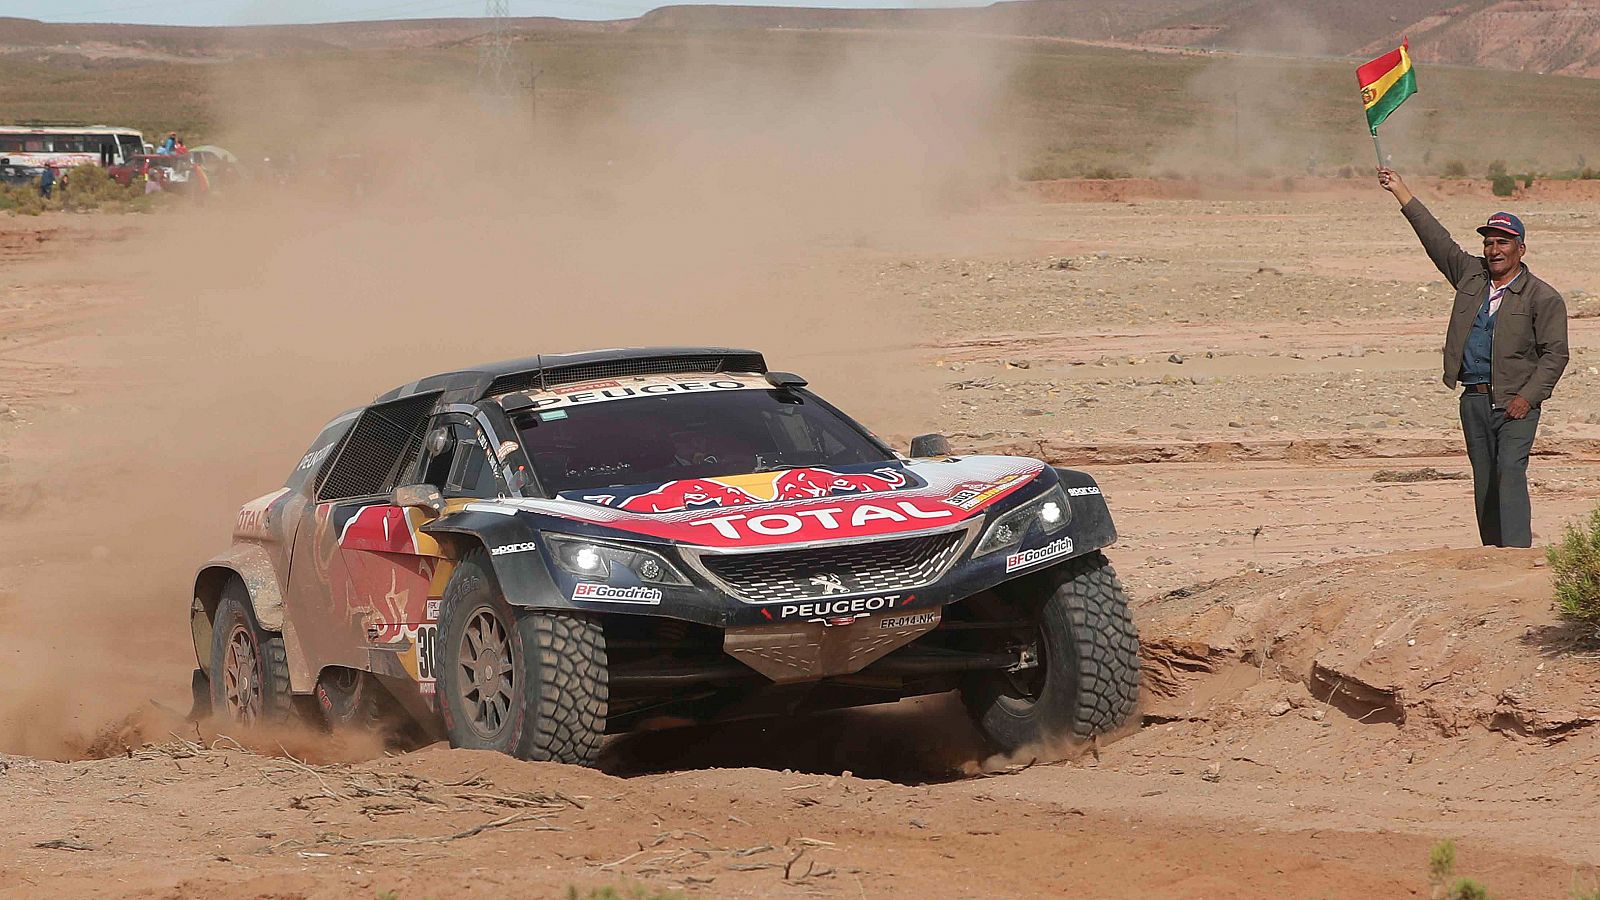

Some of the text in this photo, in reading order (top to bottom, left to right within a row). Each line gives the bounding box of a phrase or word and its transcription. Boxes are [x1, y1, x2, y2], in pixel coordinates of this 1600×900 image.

[1068, 487, 1099, 497] sparco
[237, 506, 264, 531] OTAL
[690, 501, 952, 539] TOTAL
[492, 541, 535, 556] sparco
[1008, 537, 1072, 567] BFGoodrich
[575, 584, 661, 600] BFGoodrich
[781, 595, 900, 618] PEUGEOT
[880, 612, 936, 629] ER-014-NK
